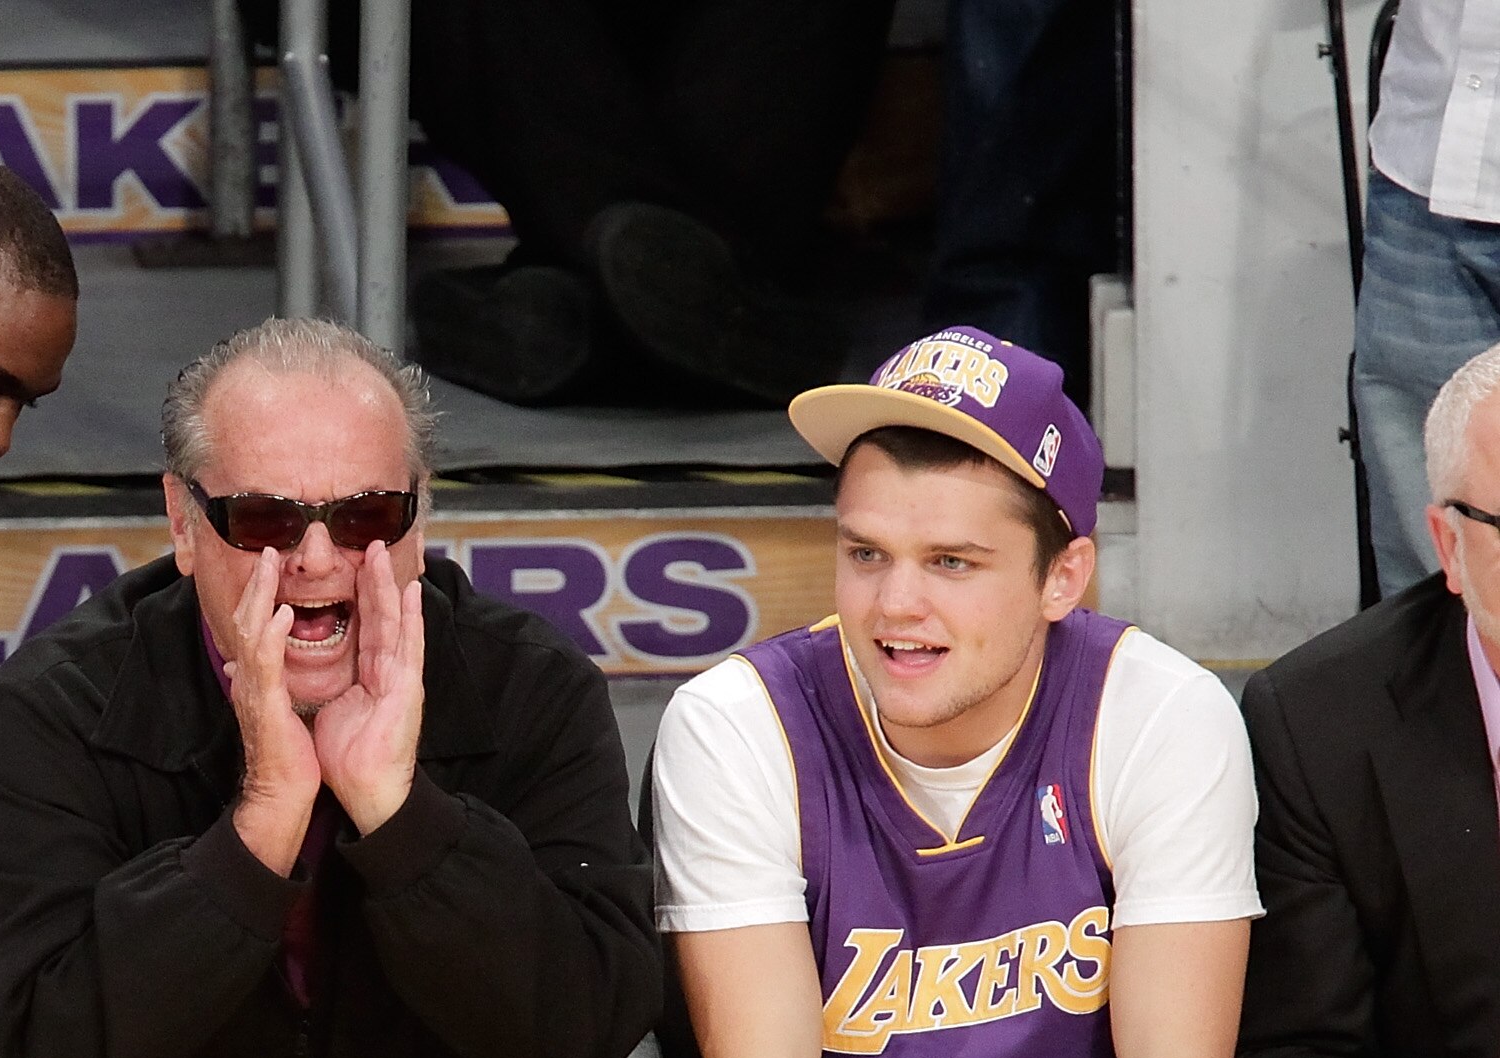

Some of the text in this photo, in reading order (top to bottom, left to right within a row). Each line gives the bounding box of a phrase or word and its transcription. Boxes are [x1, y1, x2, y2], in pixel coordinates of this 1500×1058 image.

[876, 341, 1009, 408] LAKERS
[934, 331, 994, 353] ANGELES
[821, 906, 1112, 1055] LAKERS
